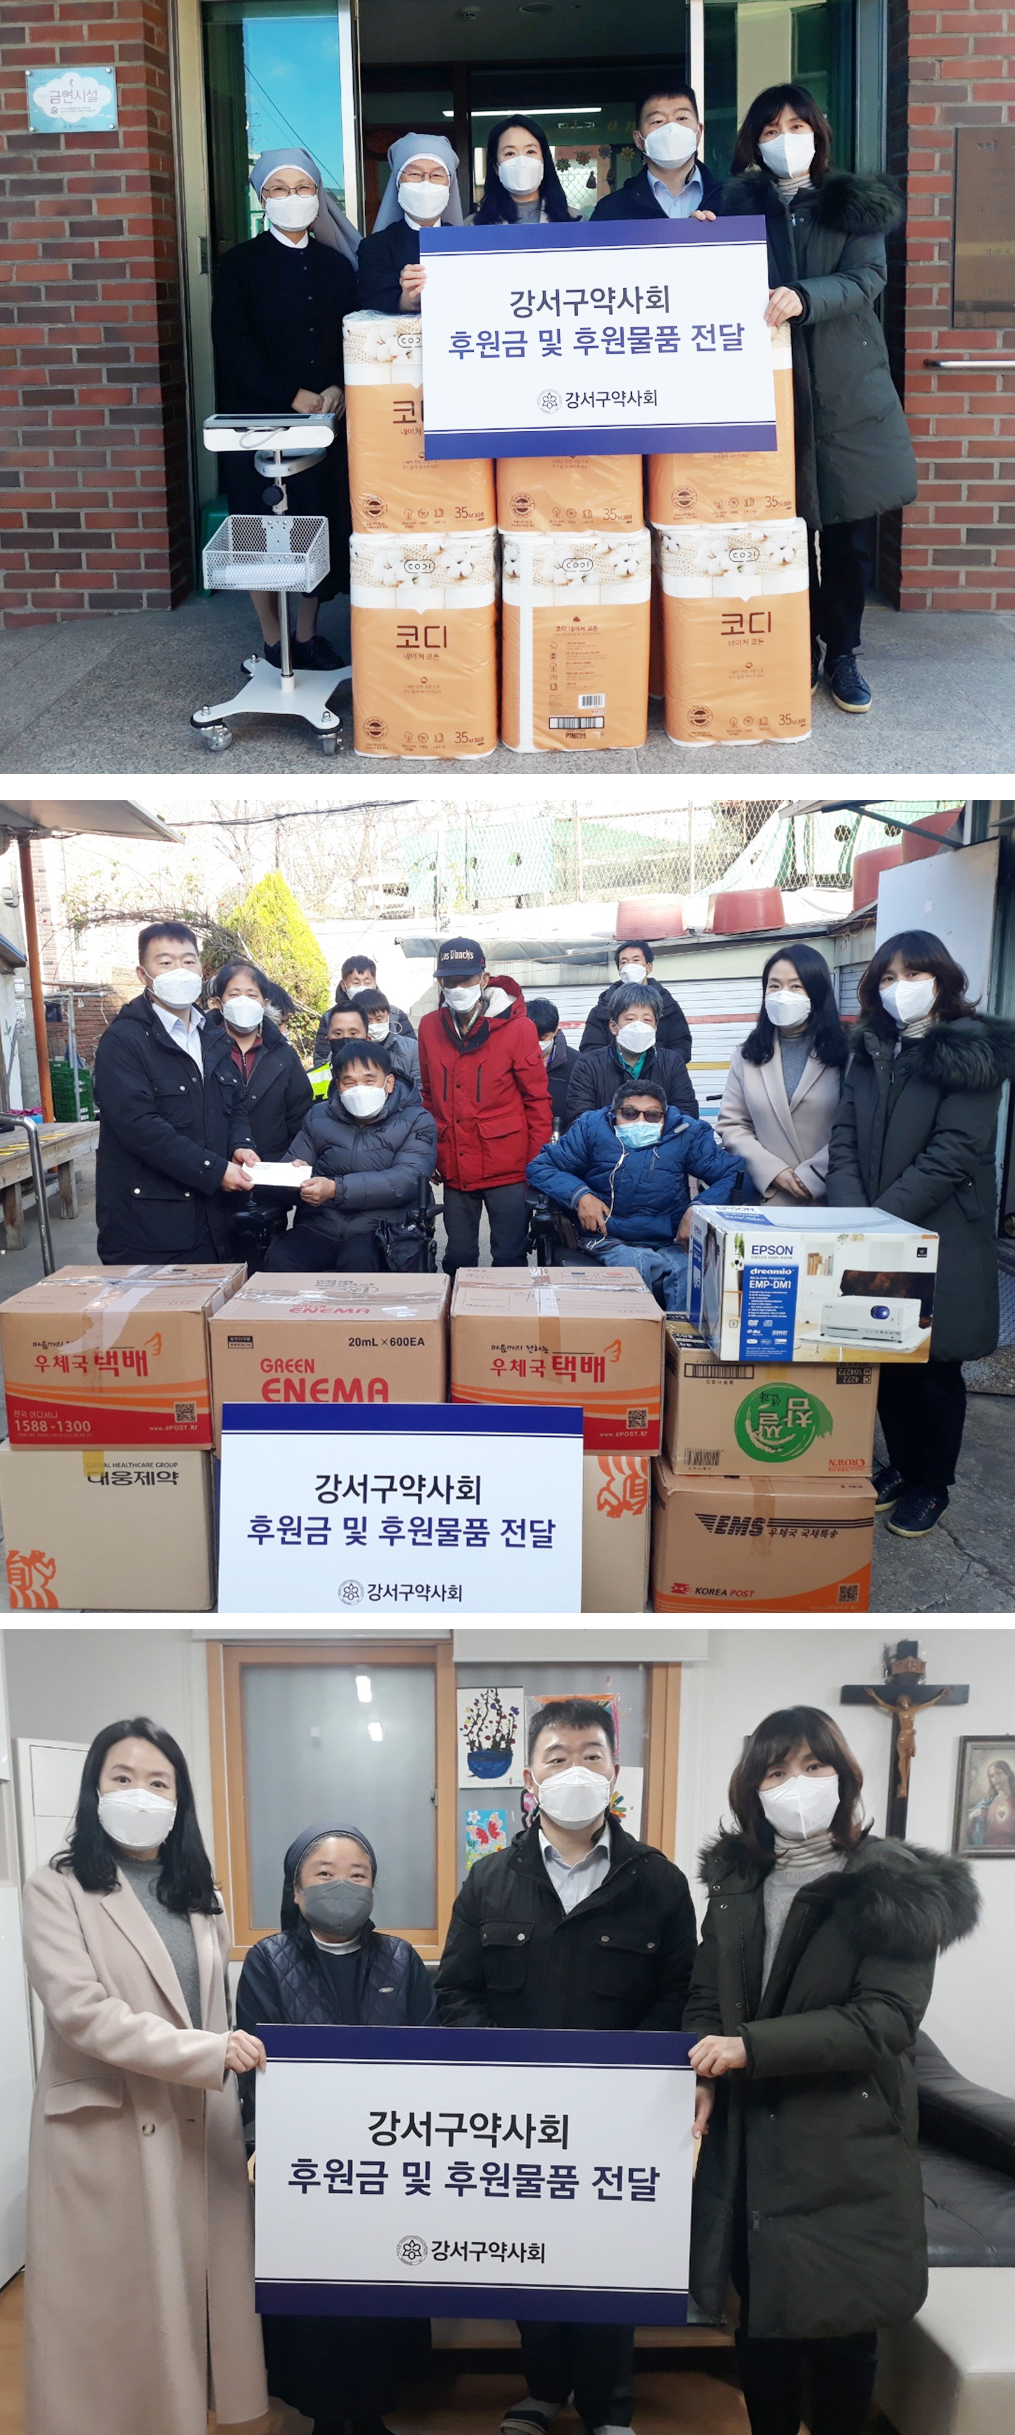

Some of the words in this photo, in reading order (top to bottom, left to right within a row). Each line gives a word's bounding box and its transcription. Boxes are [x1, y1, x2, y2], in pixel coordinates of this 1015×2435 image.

[49, 89, 98, 105] 금연시설
[509, 284, 670, 319] 강서구약사회
[448, 330, 528, 360] 후원금
[538, 328, 563, 357] 및
[573, 325, 681, 356] 후원물품
[690, 322, 745, 352] 전달
[565, 389, 658, 410] 강서구약사회
[393, 400, 424, 424] 코
[721, 611, 772, 636] 코디
[396, 625, 447, 649] 코디
[751, 1244, 794, 1256] EPSON
[750, 1267, 793, 1276] dreamio
[749, 1280, 792, 1289] EMP-DM1
[289, 1307, 371, 1315] ENEMA
[491, 1344, 523, 1354] 마음까지
[525, 1344, 550, 1354] 전하는
[34, 1354, 89, 1374] 우체국
[260, 1357, 315, 1374] GREEN
[490, 1358, 547, 1378] 우체국
[551, 1355, 606, 1384] 택배
[838, 1367, 863, 1376] 104272
[261, 1377, 389, 1403] ENEMA
[842, 1376, 860, 1384] 4272
[13, 1409, 28, 1419] 전국
[29, 1410, 59, 1419] 어디서나
[14, 1420, 91, 1433] 1588-1300
[87, 1470, 180, 1486] 대웅제약
[314, 1473, 481, 1505] 강서구약사회
[247, 1515, 332, 1546] 후원금
[343, 1515, 368, 1547] 및
[378, 1515, 490, 1548] 후원물품
[500, 1517, 556, 1549] 전달
[714, 1515, 766, 1537] EMS
[768, 1528, 798, 1539] 우체국
[800, 1528, 839, 1540] 국제특송
[366, 1582, 463, 1603] 강서구약사회
[694, 1586, 728, 1597] KOREA
[729, 1588, 756, 1598] POST
[367, 2109, 569, 2150] 강서구약사회
[287, 2157, 389, 2195] 후원금
[401, 2159, 432, 2197] 및
[444, 2159, 580, 2200] 후원물품
[591, 2164, 661, 2202] 전달
[430, 2239, 546, 2264] 강서구약사회
